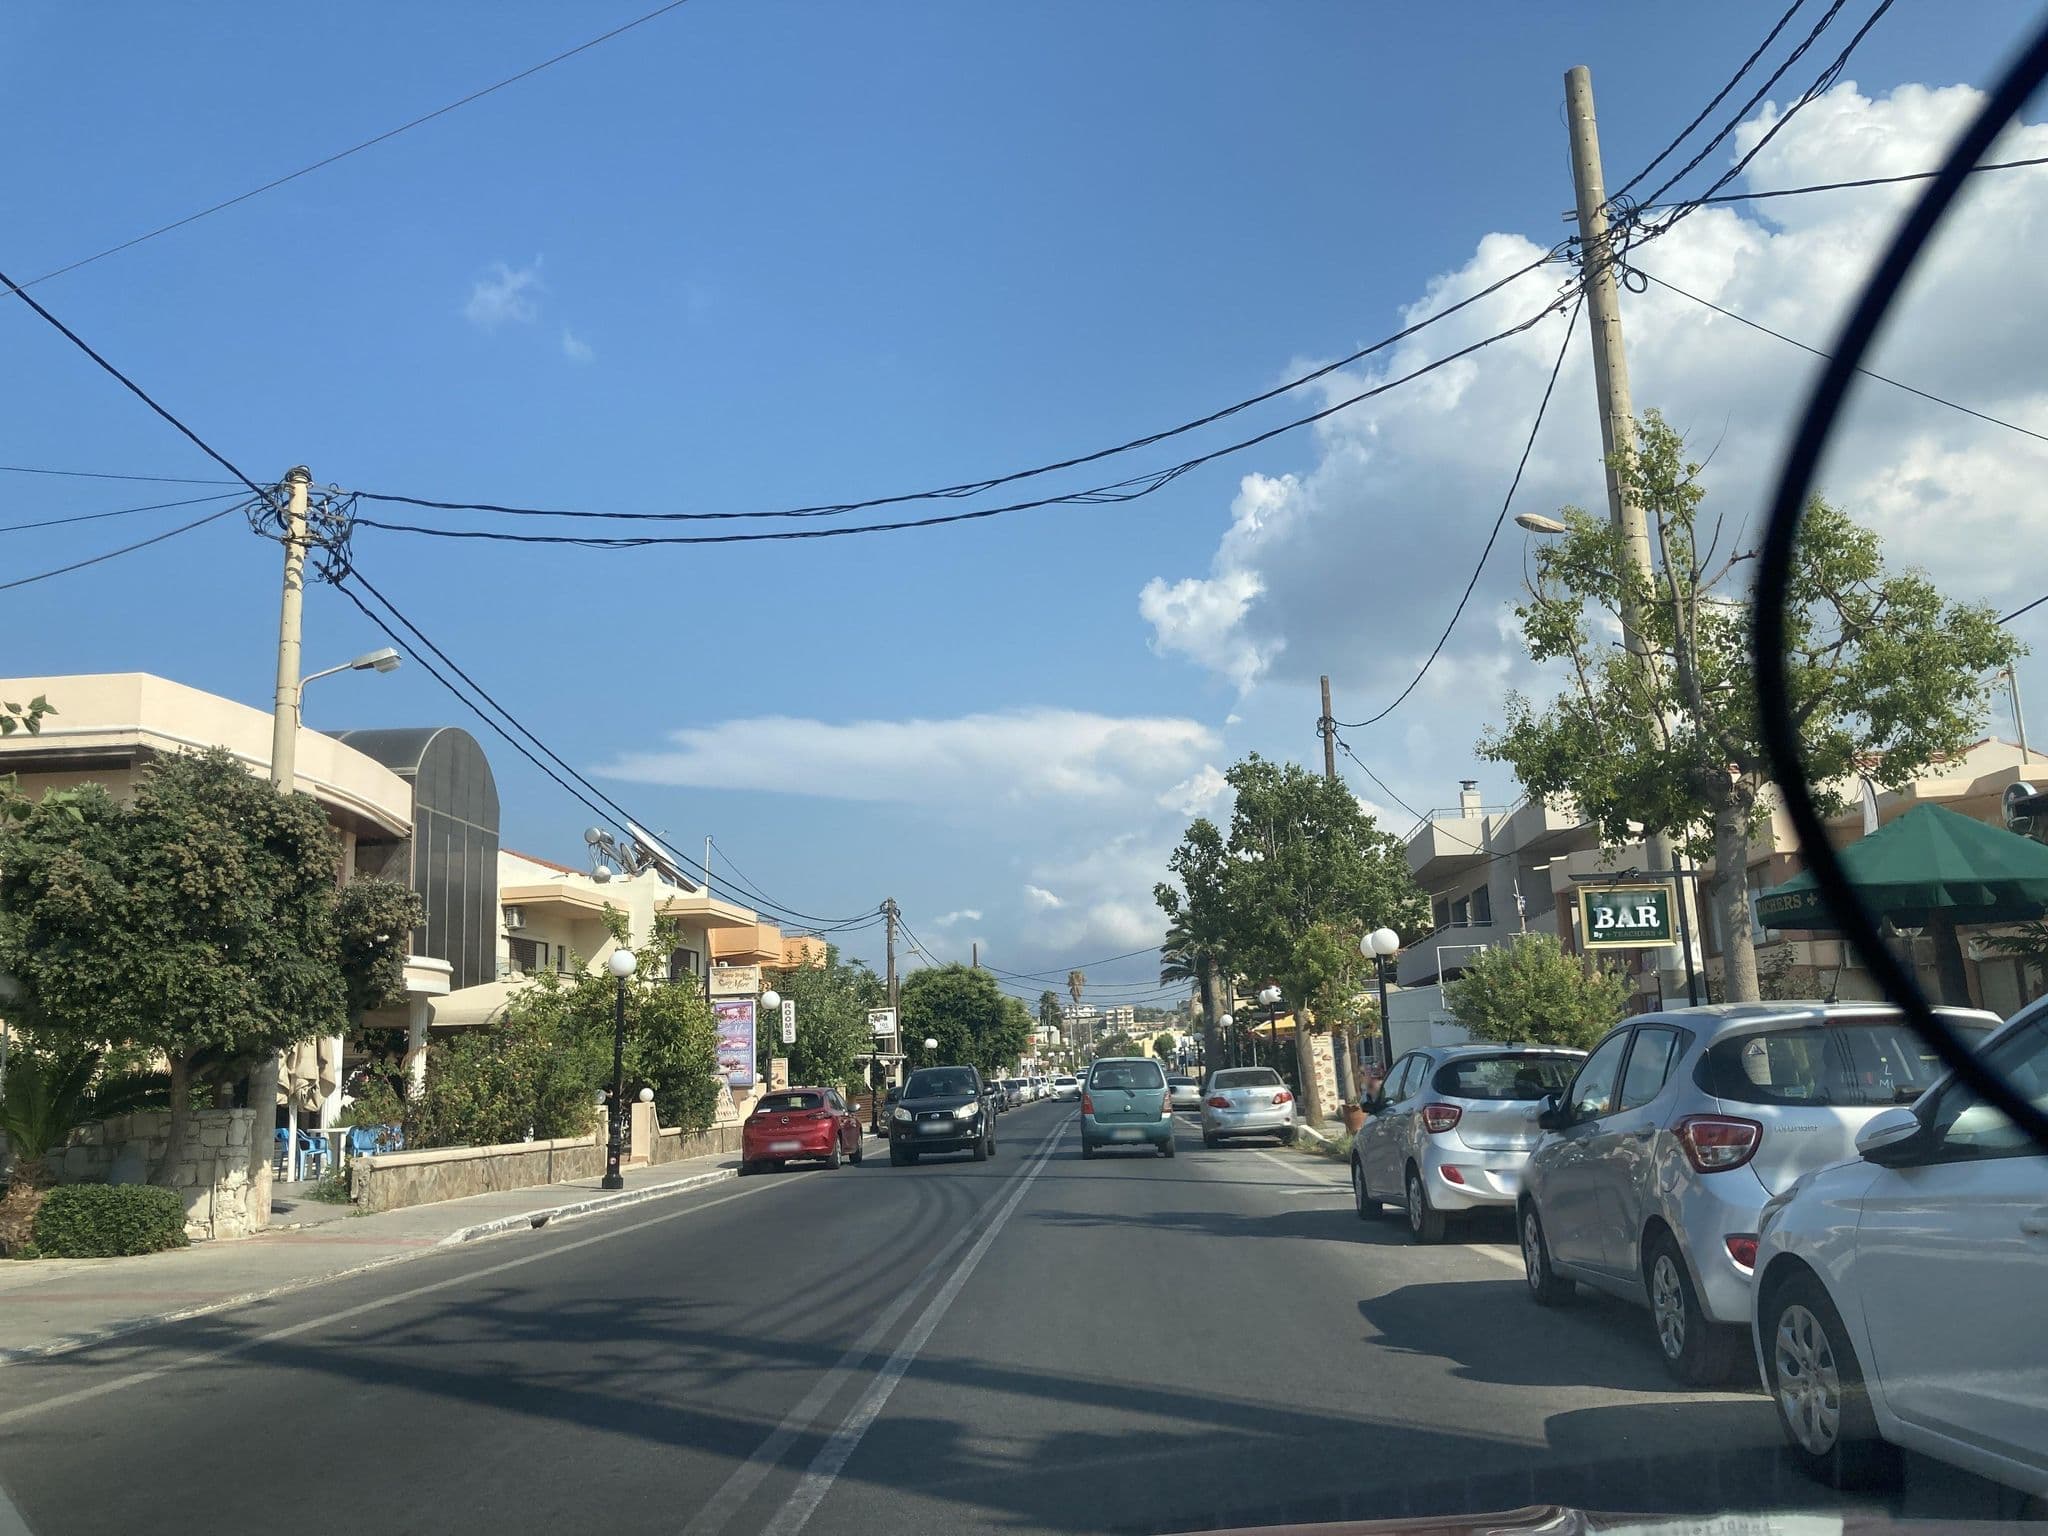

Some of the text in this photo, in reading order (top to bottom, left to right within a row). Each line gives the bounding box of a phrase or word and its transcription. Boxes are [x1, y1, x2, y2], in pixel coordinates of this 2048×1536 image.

[1592, 905, 1661, 929] BAR
[1593, 931, 1604, 939] By
[784, 1003, 792, 1036] ROOMS
